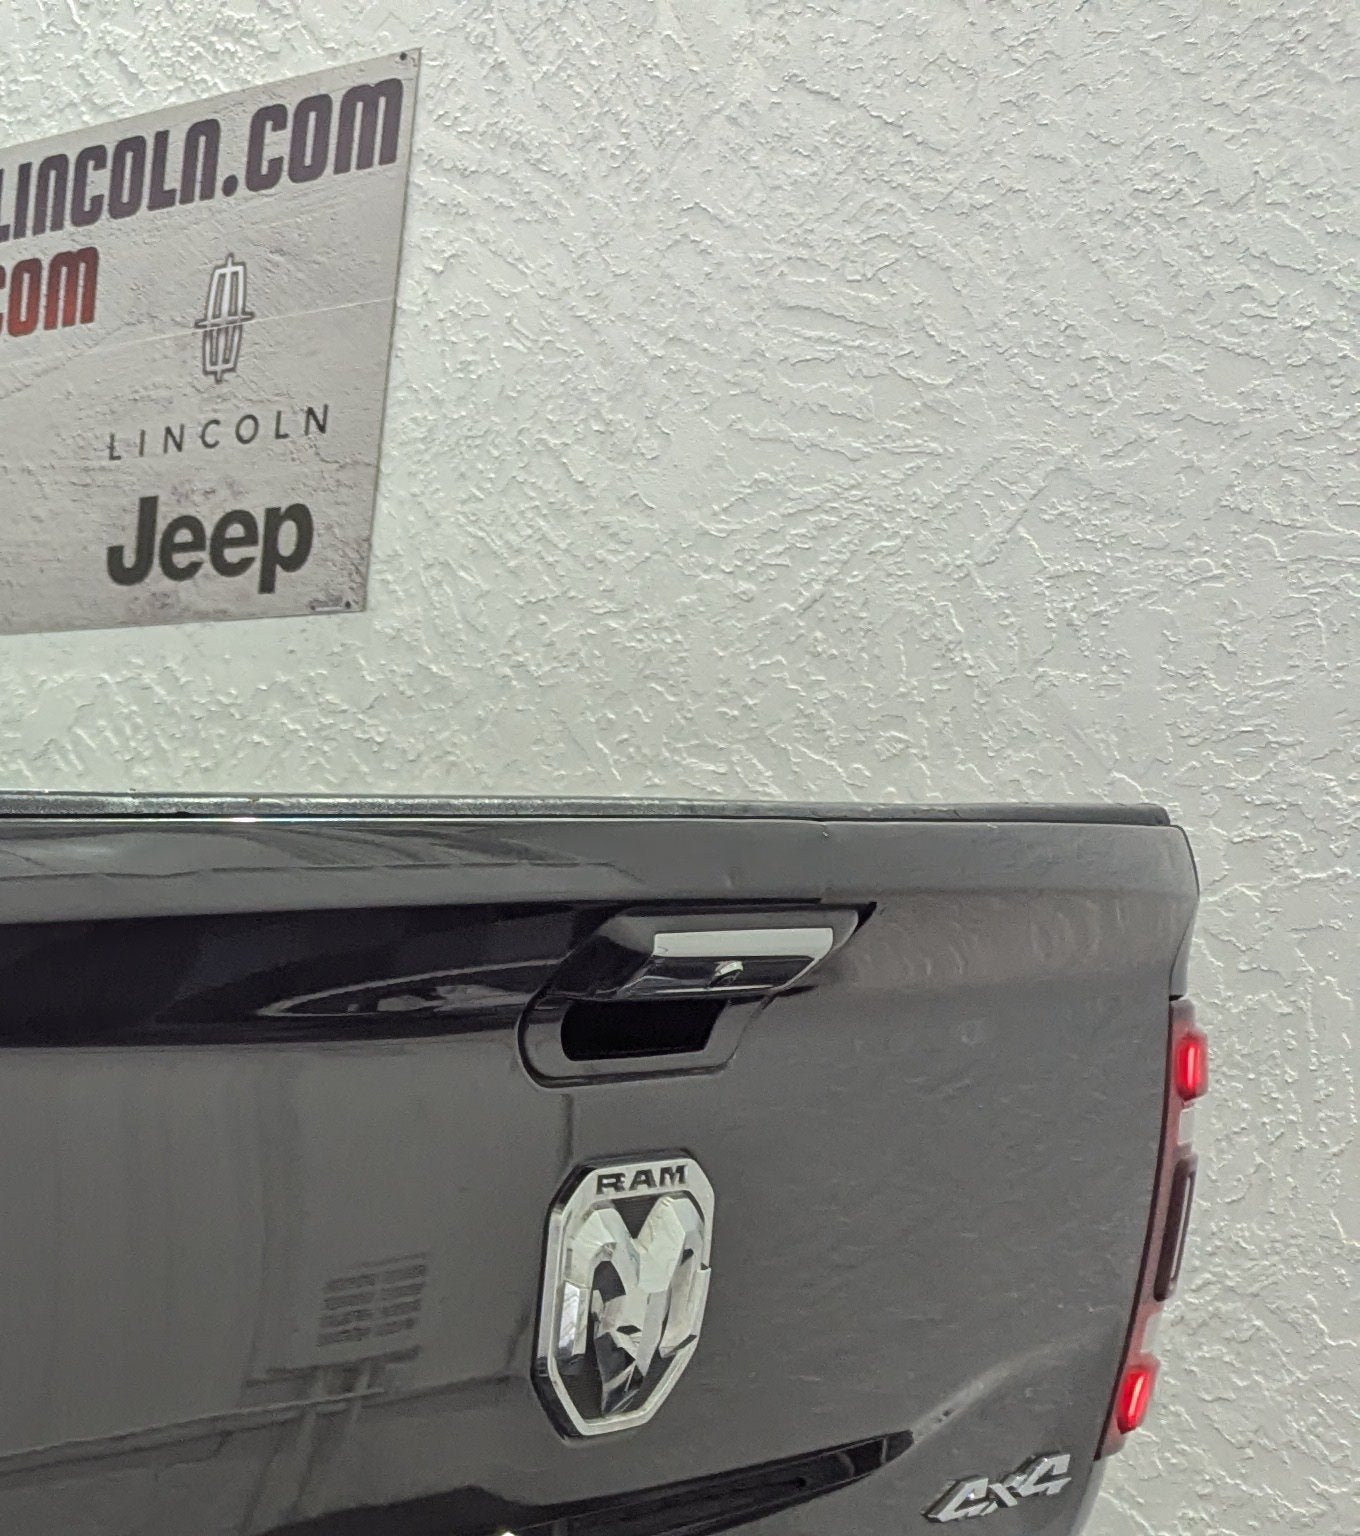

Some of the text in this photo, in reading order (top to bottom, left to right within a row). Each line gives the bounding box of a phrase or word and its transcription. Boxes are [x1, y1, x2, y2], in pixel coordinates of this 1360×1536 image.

[107, 404, 330, 461] LINCOLN
[106, 495, 316, 593] Jeep
[595, 1165, 688, 1194] RAM
